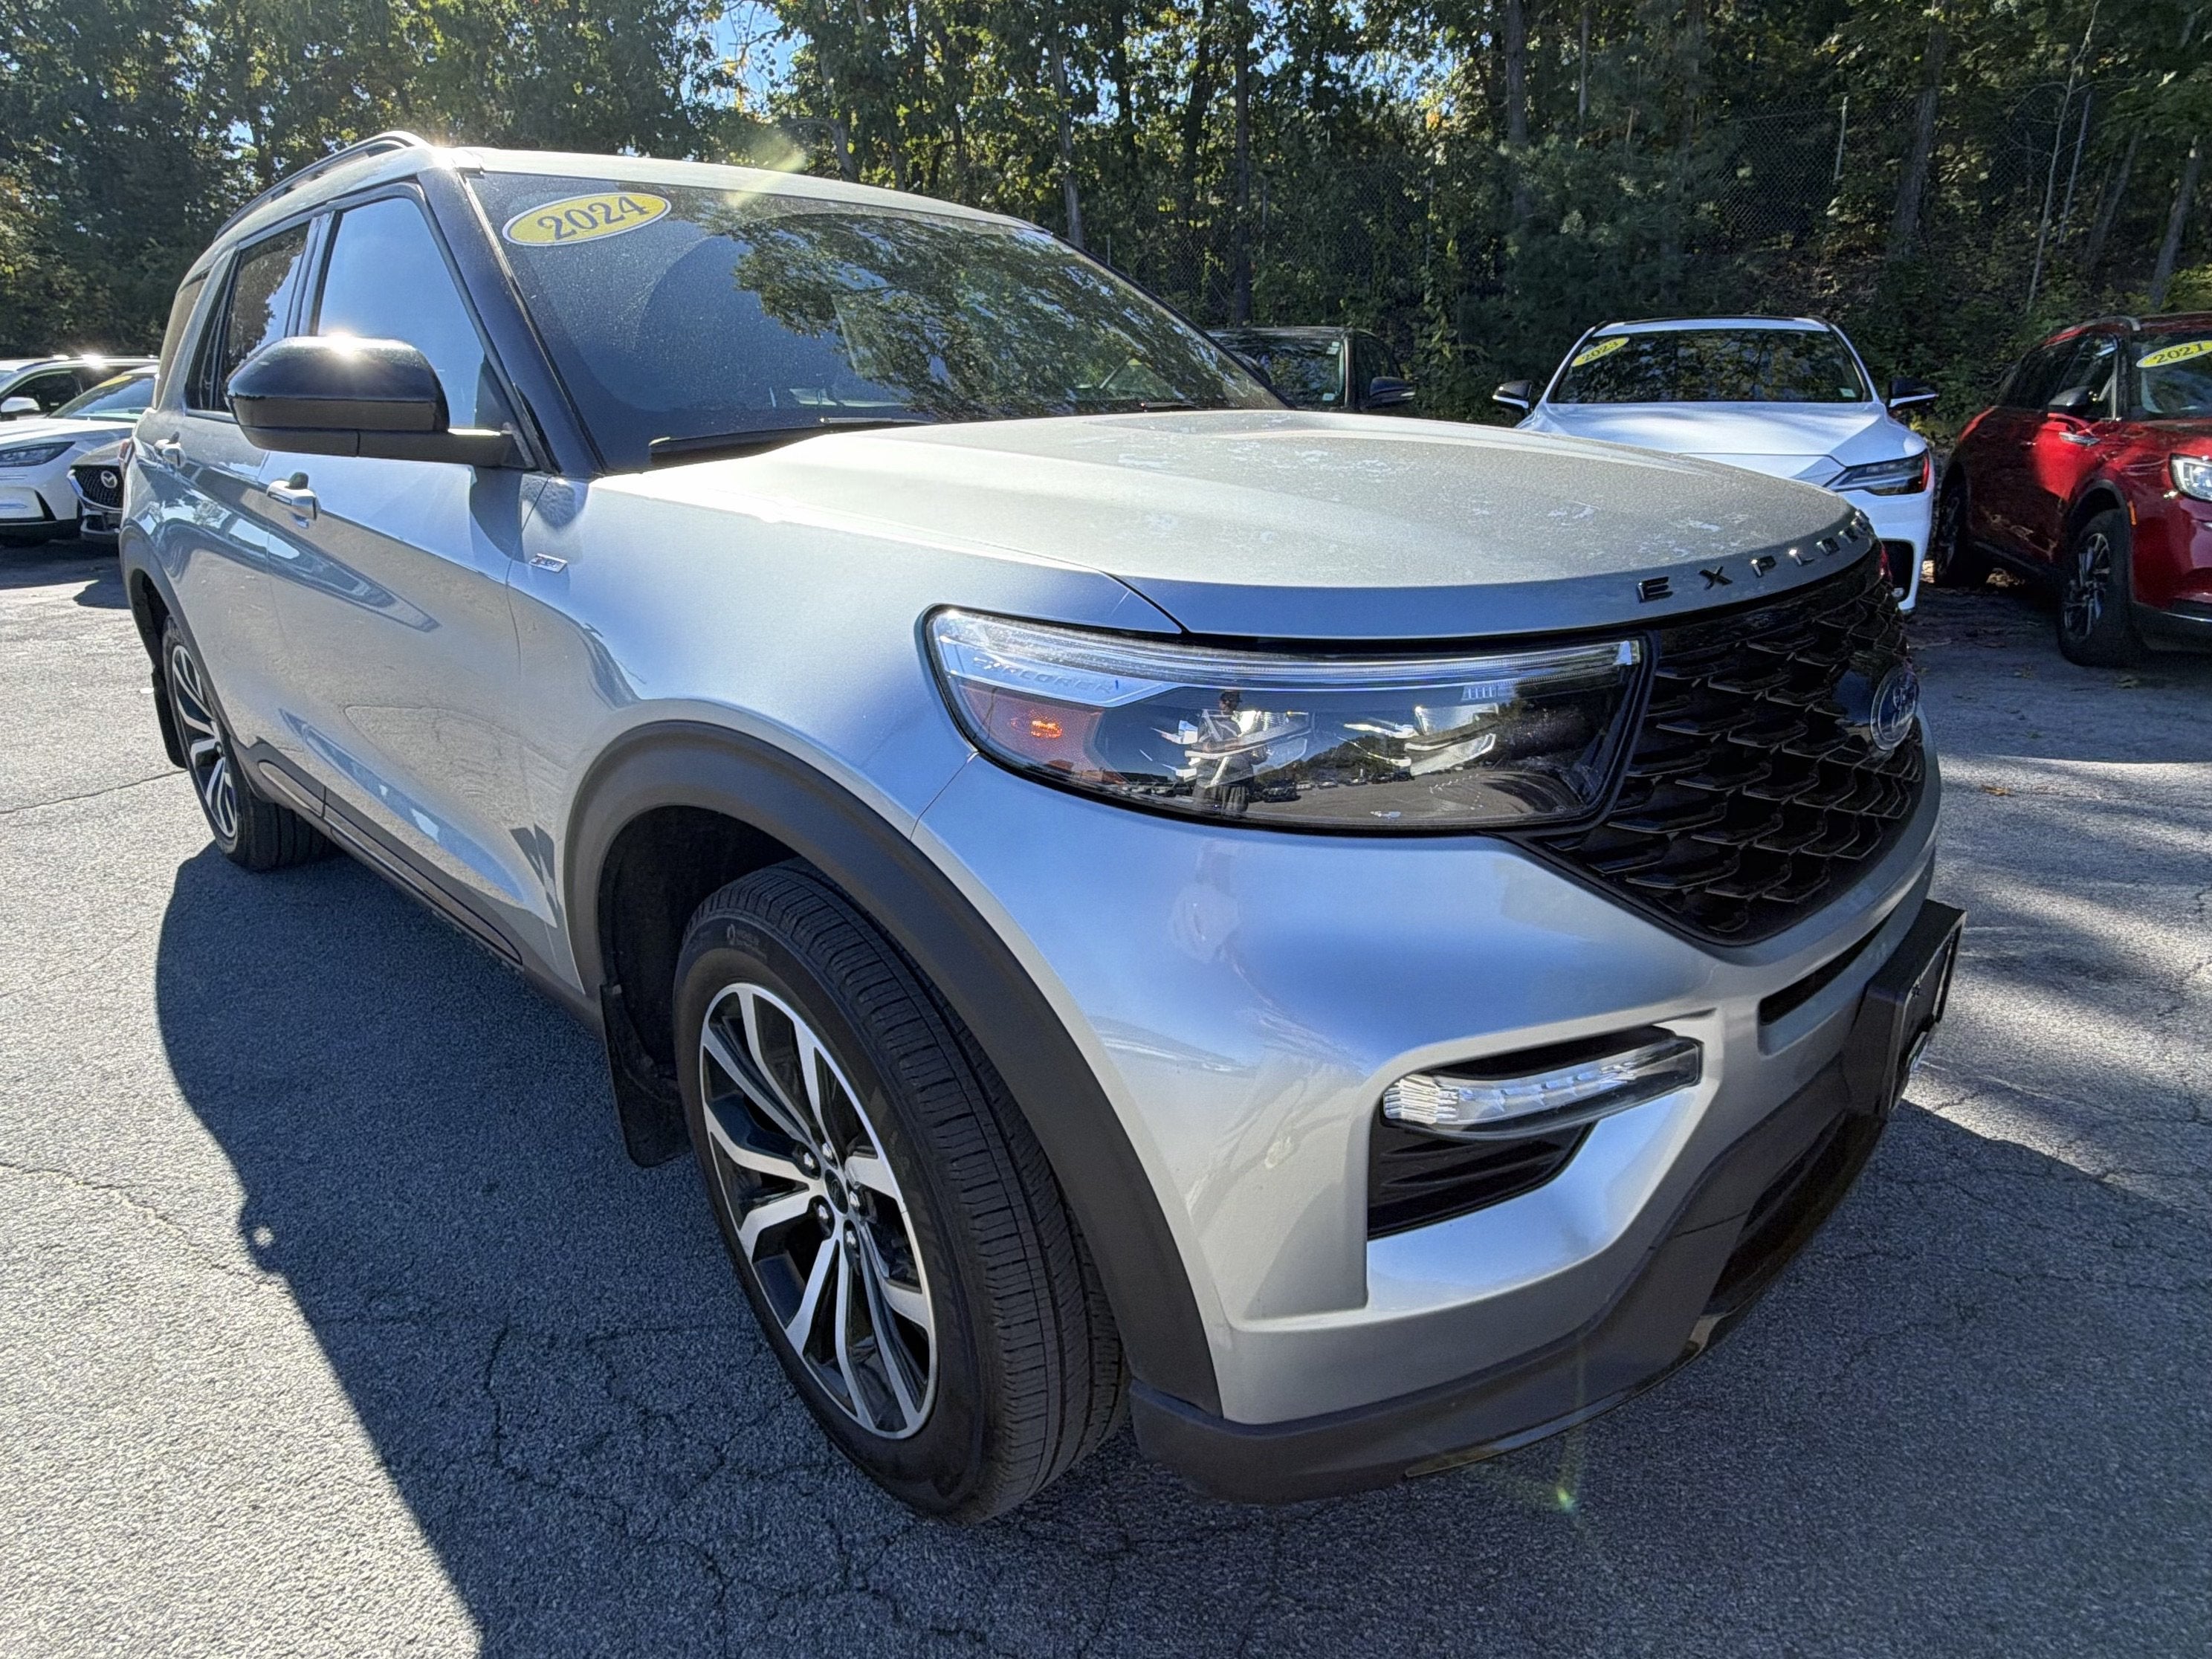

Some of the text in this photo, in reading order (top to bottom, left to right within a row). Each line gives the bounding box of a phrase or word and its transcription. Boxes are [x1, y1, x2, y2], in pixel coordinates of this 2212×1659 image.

[537, 196, 650, 240] 2024
[1582, 342, 1618, 360] 2023
[2153, 343, 2205, 363] 2021
[1637, 509, 1870, 604] EXPLOR
